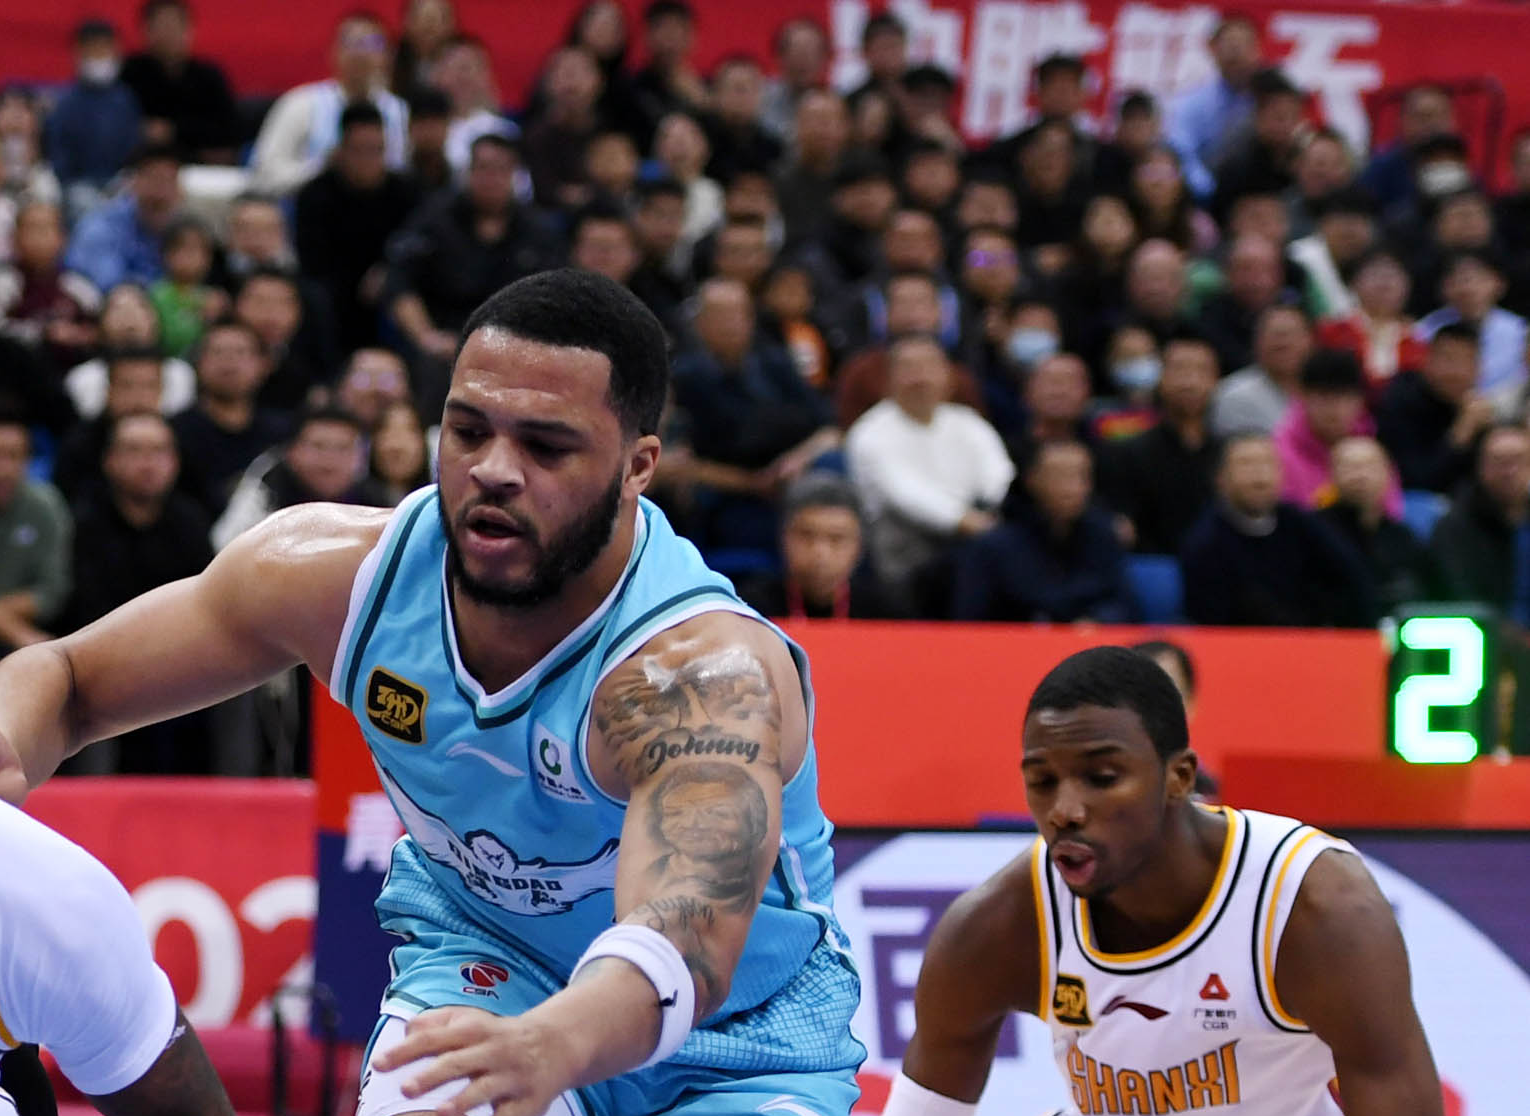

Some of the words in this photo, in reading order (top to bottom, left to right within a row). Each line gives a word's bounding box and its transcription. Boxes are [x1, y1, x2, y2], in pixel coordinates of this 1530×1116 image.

[1394, 616, 1485, 765] 2
[647, 734, 760, 775] Johnny
[1067, 1038, 1241, 1116] SHANXI
